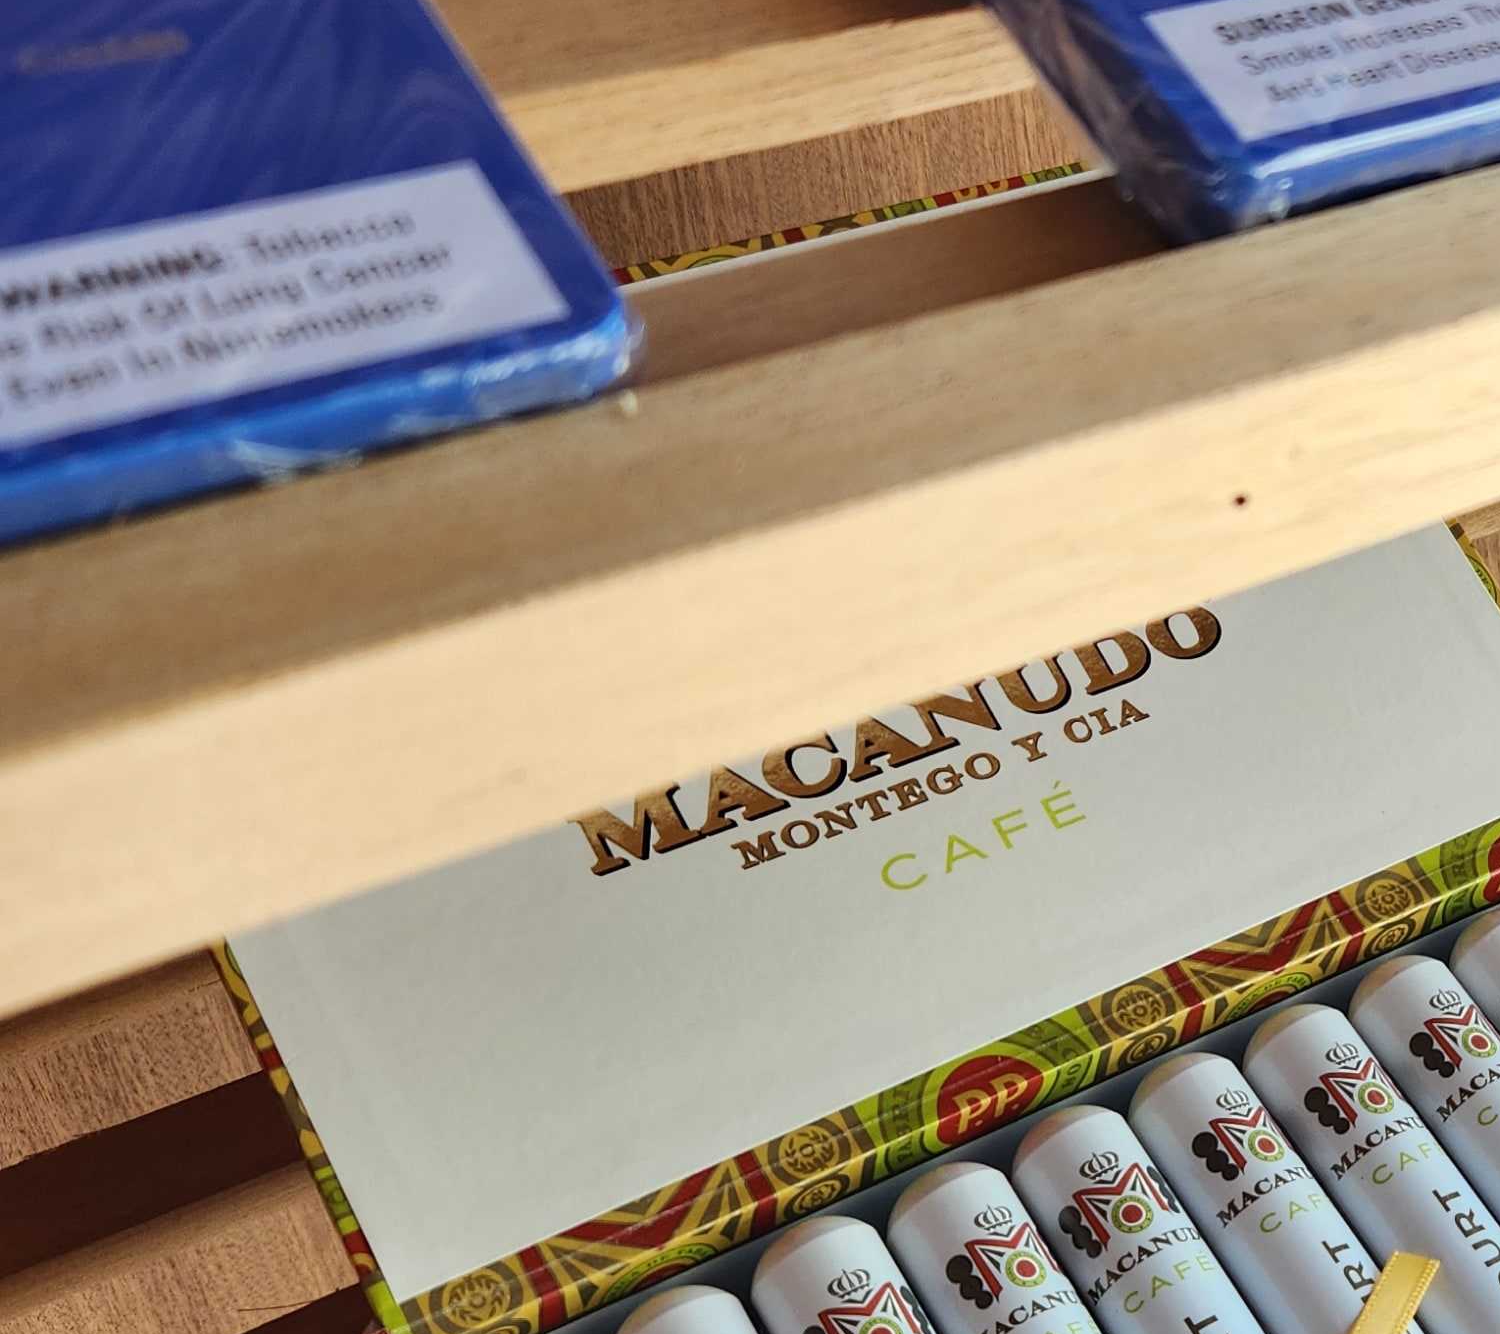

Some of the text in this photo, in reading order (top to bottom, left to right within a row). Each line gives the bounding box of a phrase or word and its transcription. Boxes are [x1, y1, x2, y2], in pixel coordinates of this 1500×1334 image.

[1214, 0, 1352, 47] SURGEON
[1235, 36, 1337, 79] Smoke
[1338, 11, 1467, 56] Increases
[1325, 57, 1402, 97] eart
[567, 602, 1222, 876] MACANUDO
[731, 697, 1150, 870] MONTEGO Y CIA
[880, 780, 1087, 892] CAFÉ
[1372, 1139, 1444, 1186] CAF
[1259, 1192, 1331, 1234] CAF
[1123, 1249, 1215, 1314] CAFÉ
